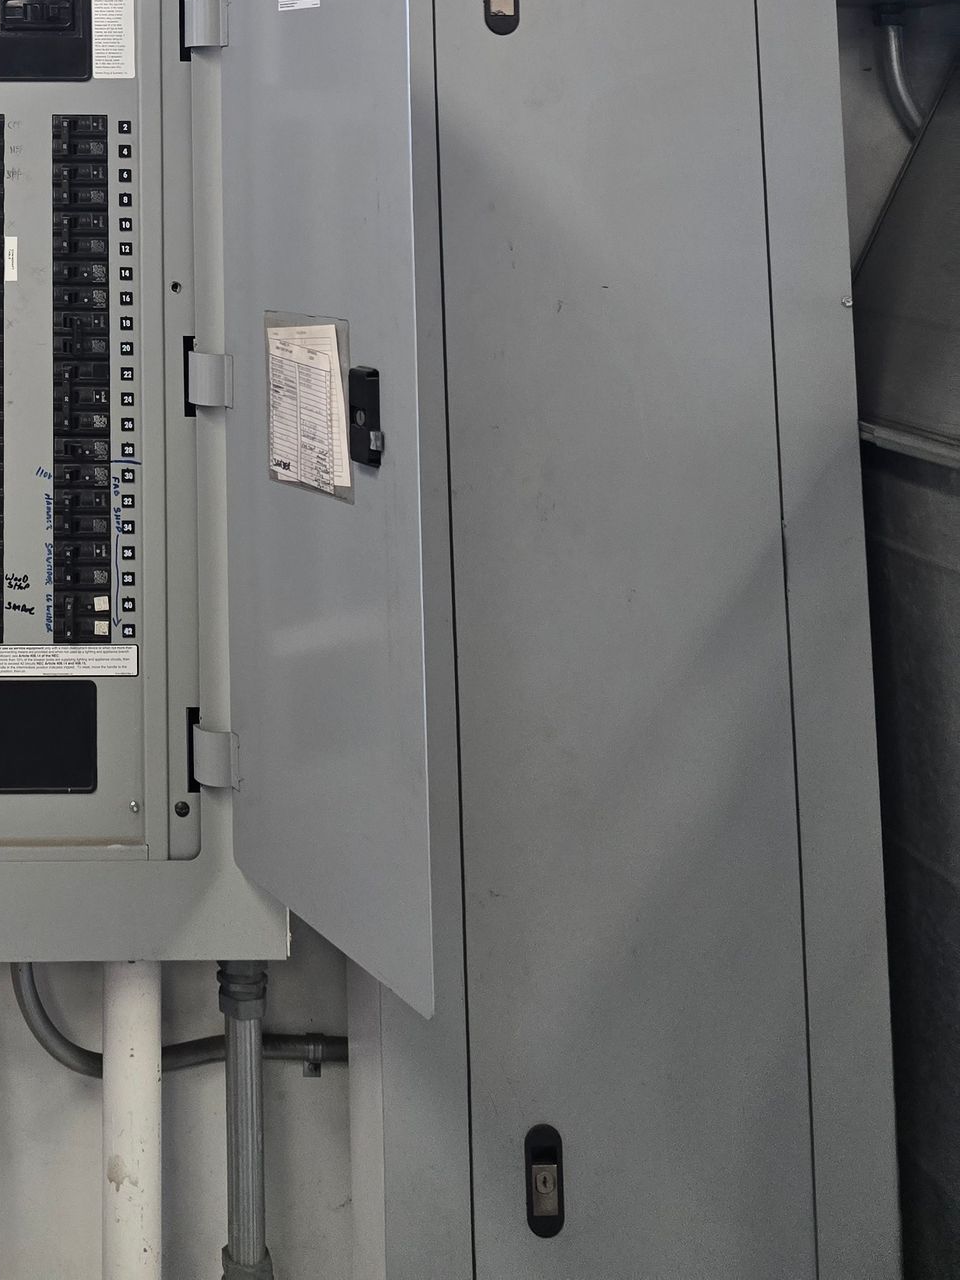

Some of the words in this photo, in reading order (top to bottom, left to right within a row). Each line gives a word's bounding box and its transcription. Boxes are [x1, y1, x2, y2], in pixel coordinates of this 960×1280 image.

[121, 220, 131, 229] 10
[121, 245, 130, 253] 12
[121, 269, 130, 277] 14
[122, 294, 131, 302] 16
[122, 319, 131, 327] 18
[121, 344, 131, 352] 20
[123, 370, 132, 379] 22
[123, 395, 133, 404] 24
[123, 421, 133, 429] 26
[124, 446, 134, 454] 28
[124, 471, 134, 480] 30
[123, 497, 133, 506] 32
[123, 523, 133, 532] 34
[123, 549, 133, 558] 36
[5, 573, 29, 583] WOOD
[123, 574, 133, 583] 38
[7, 581, 30, 590] SHOP
[123, 601, 133, 609] 40
[123, 627, 133, 636] 42
